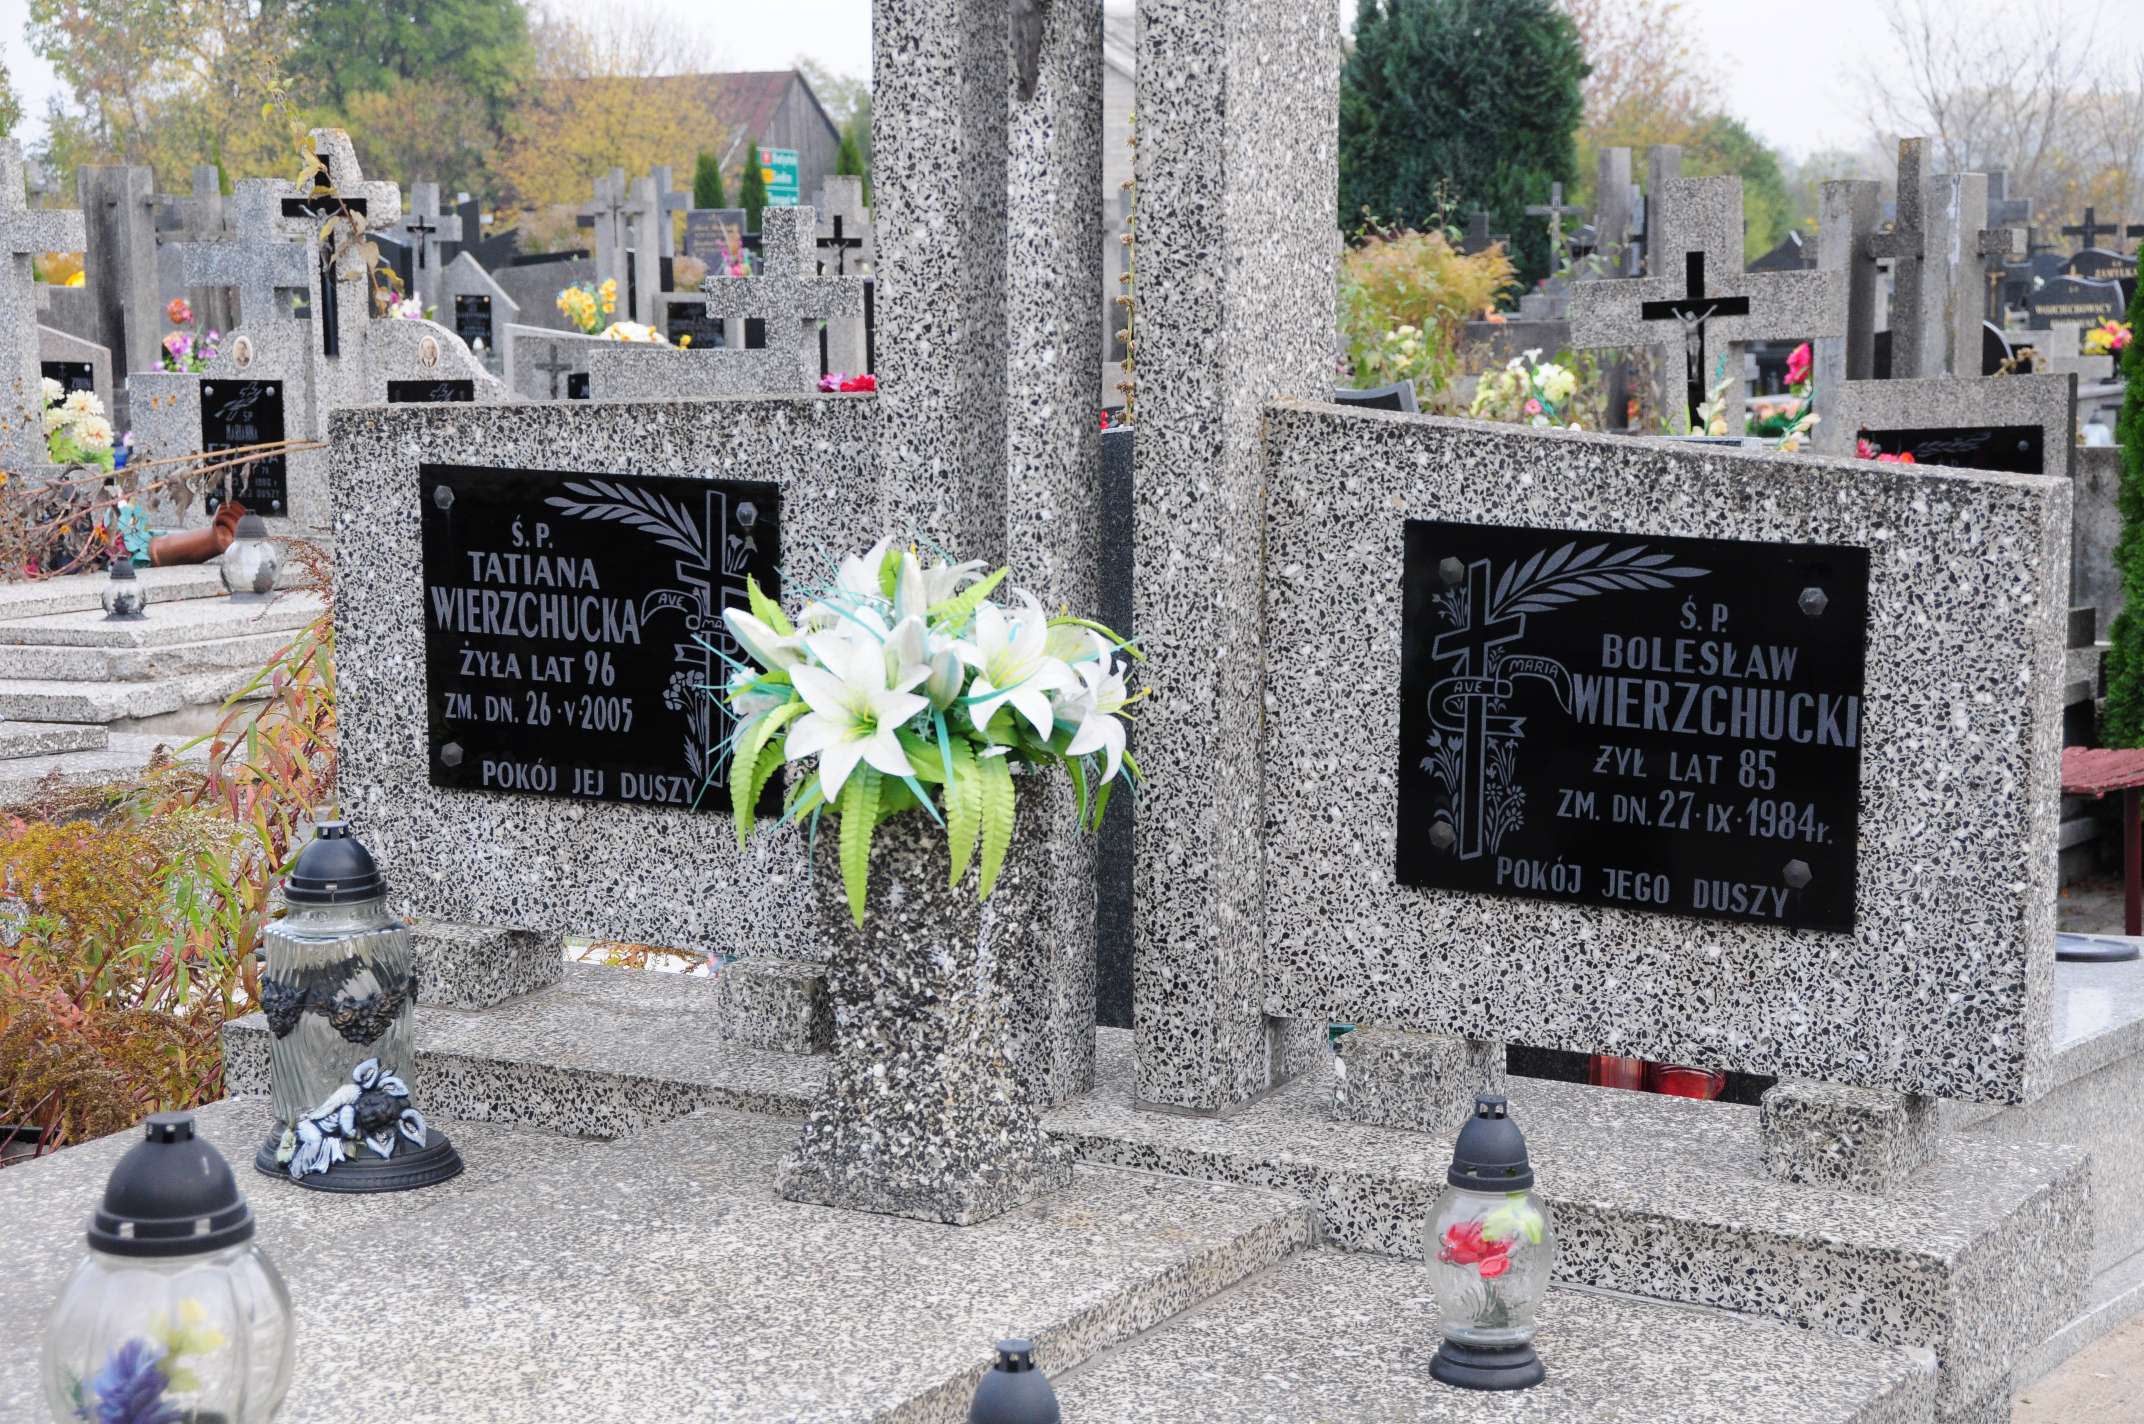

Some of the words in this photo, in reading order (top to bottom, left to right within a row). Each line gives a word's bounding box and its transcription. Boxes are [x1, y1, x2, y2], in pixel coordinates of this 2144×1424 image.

[467, 551, 599, 590] TATIANA
[431, 586, 640, 645] WIERZCHUCKA
[659, 592, 685, 606] AVE
[460, 641, 521, 679] ŻYŁA
[532, 655, 574, 682] LAT
[585, 651, 614, 686] 96
[1454, 681, 1482, 693] AVE
[1509, 659, 1559, 679] MARIA
[1601, 635, 1796, 681] BOLESŁAW
[445, 693, 477, 720] ZM.
[486, 696, 518, 723] DN.
[1574, 673, 1858, 748] WIERZCHUCKI
[483, 758, 556, 793] POKÓJ
[573, 769, 603, 795] JEJ
[620, 773, 695, 804] DUSZY
[1670, 752, 1722, 784] LAT
[1740, 750, 1775, 789] 85
[1557, 790, 1599, 820] ZM.
[1614, 795, 1651, 825] DN.
[1498, 856, 1580, 893] POKÓJ
[1603, 869, 1669, 903] JEGO
[1694, 879, 1787, 917] DUSZY
